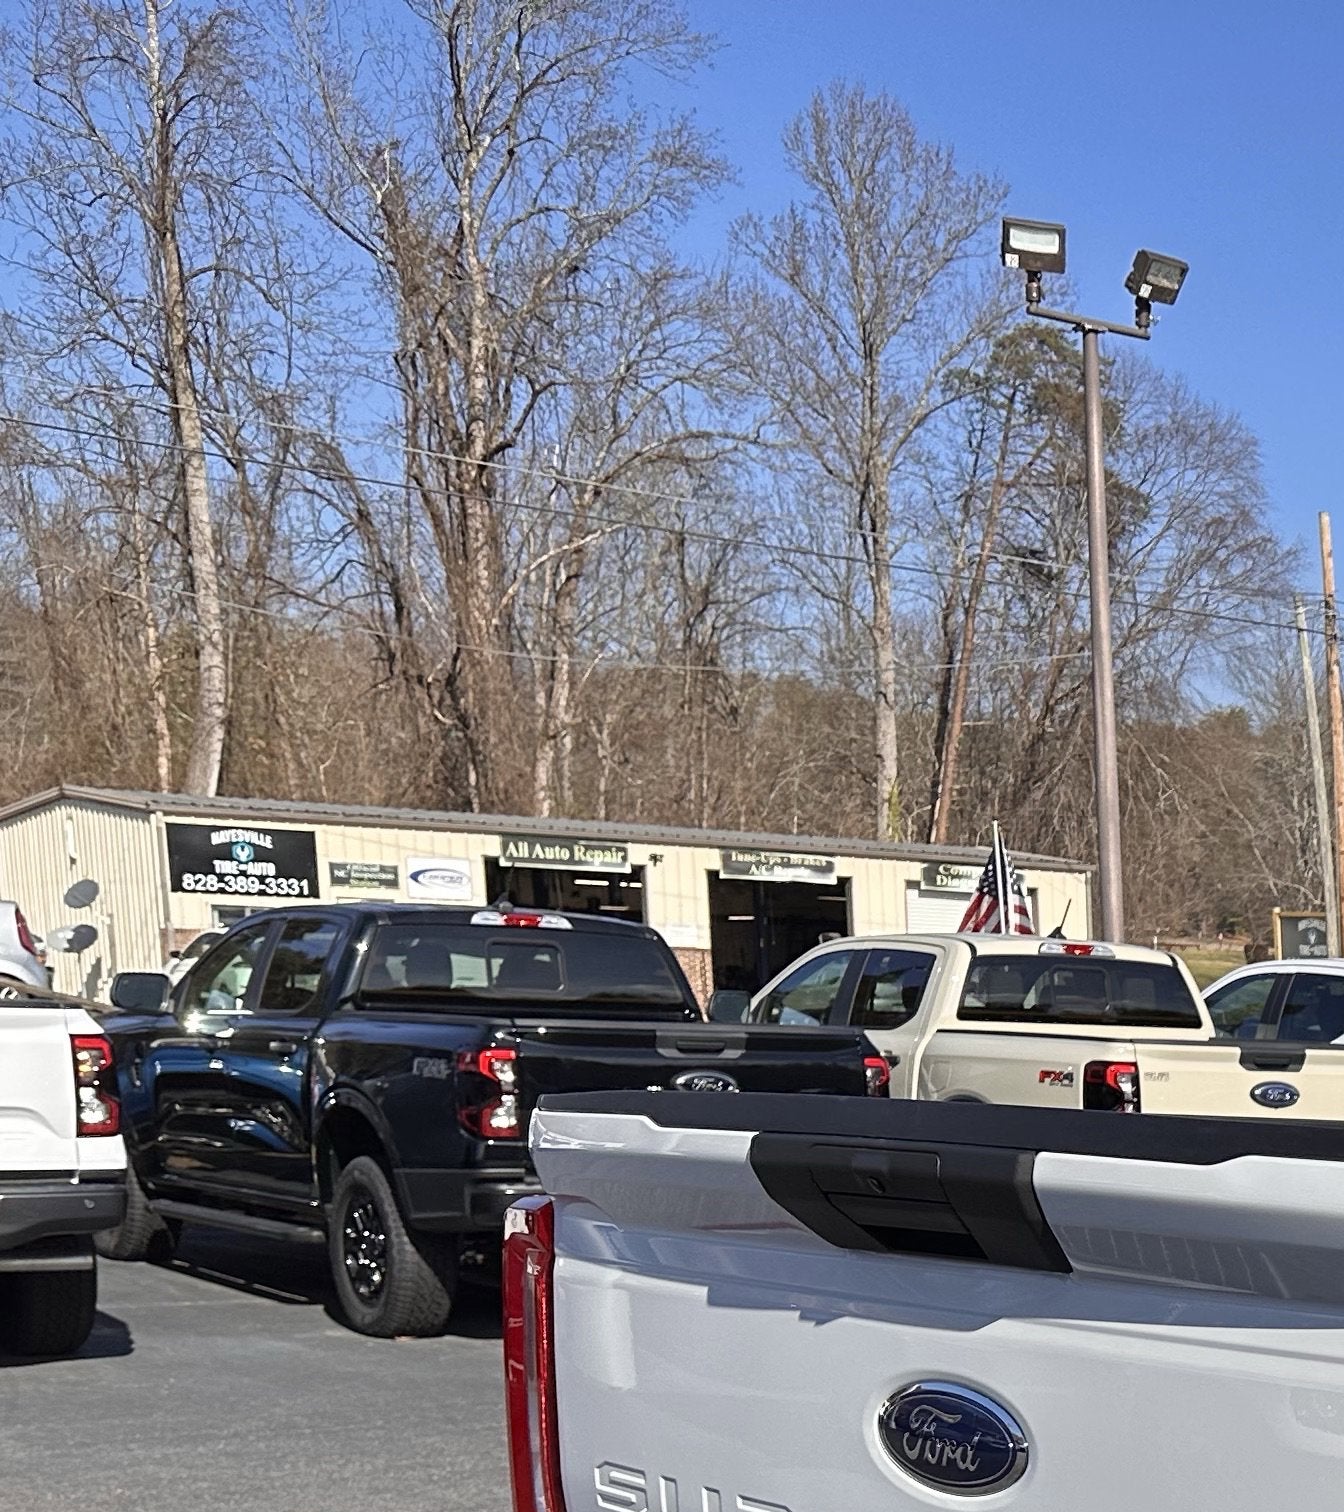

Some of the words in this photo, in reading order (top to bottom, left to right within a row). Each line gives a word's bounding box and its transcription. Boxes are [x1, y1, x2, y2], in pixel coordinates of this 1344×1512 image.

[210, 829, 274, 849] HAYESVILLE
[505, 841, 530, 858] All
[532, 843, 571, 861] Auto
[573, 844, 625, 867] Repair
[181, 872, 309, 896] 828-389-3331
[1039, 1066, 1074, 1083] FX4
[903, 1404, 981, 1472] Ford
